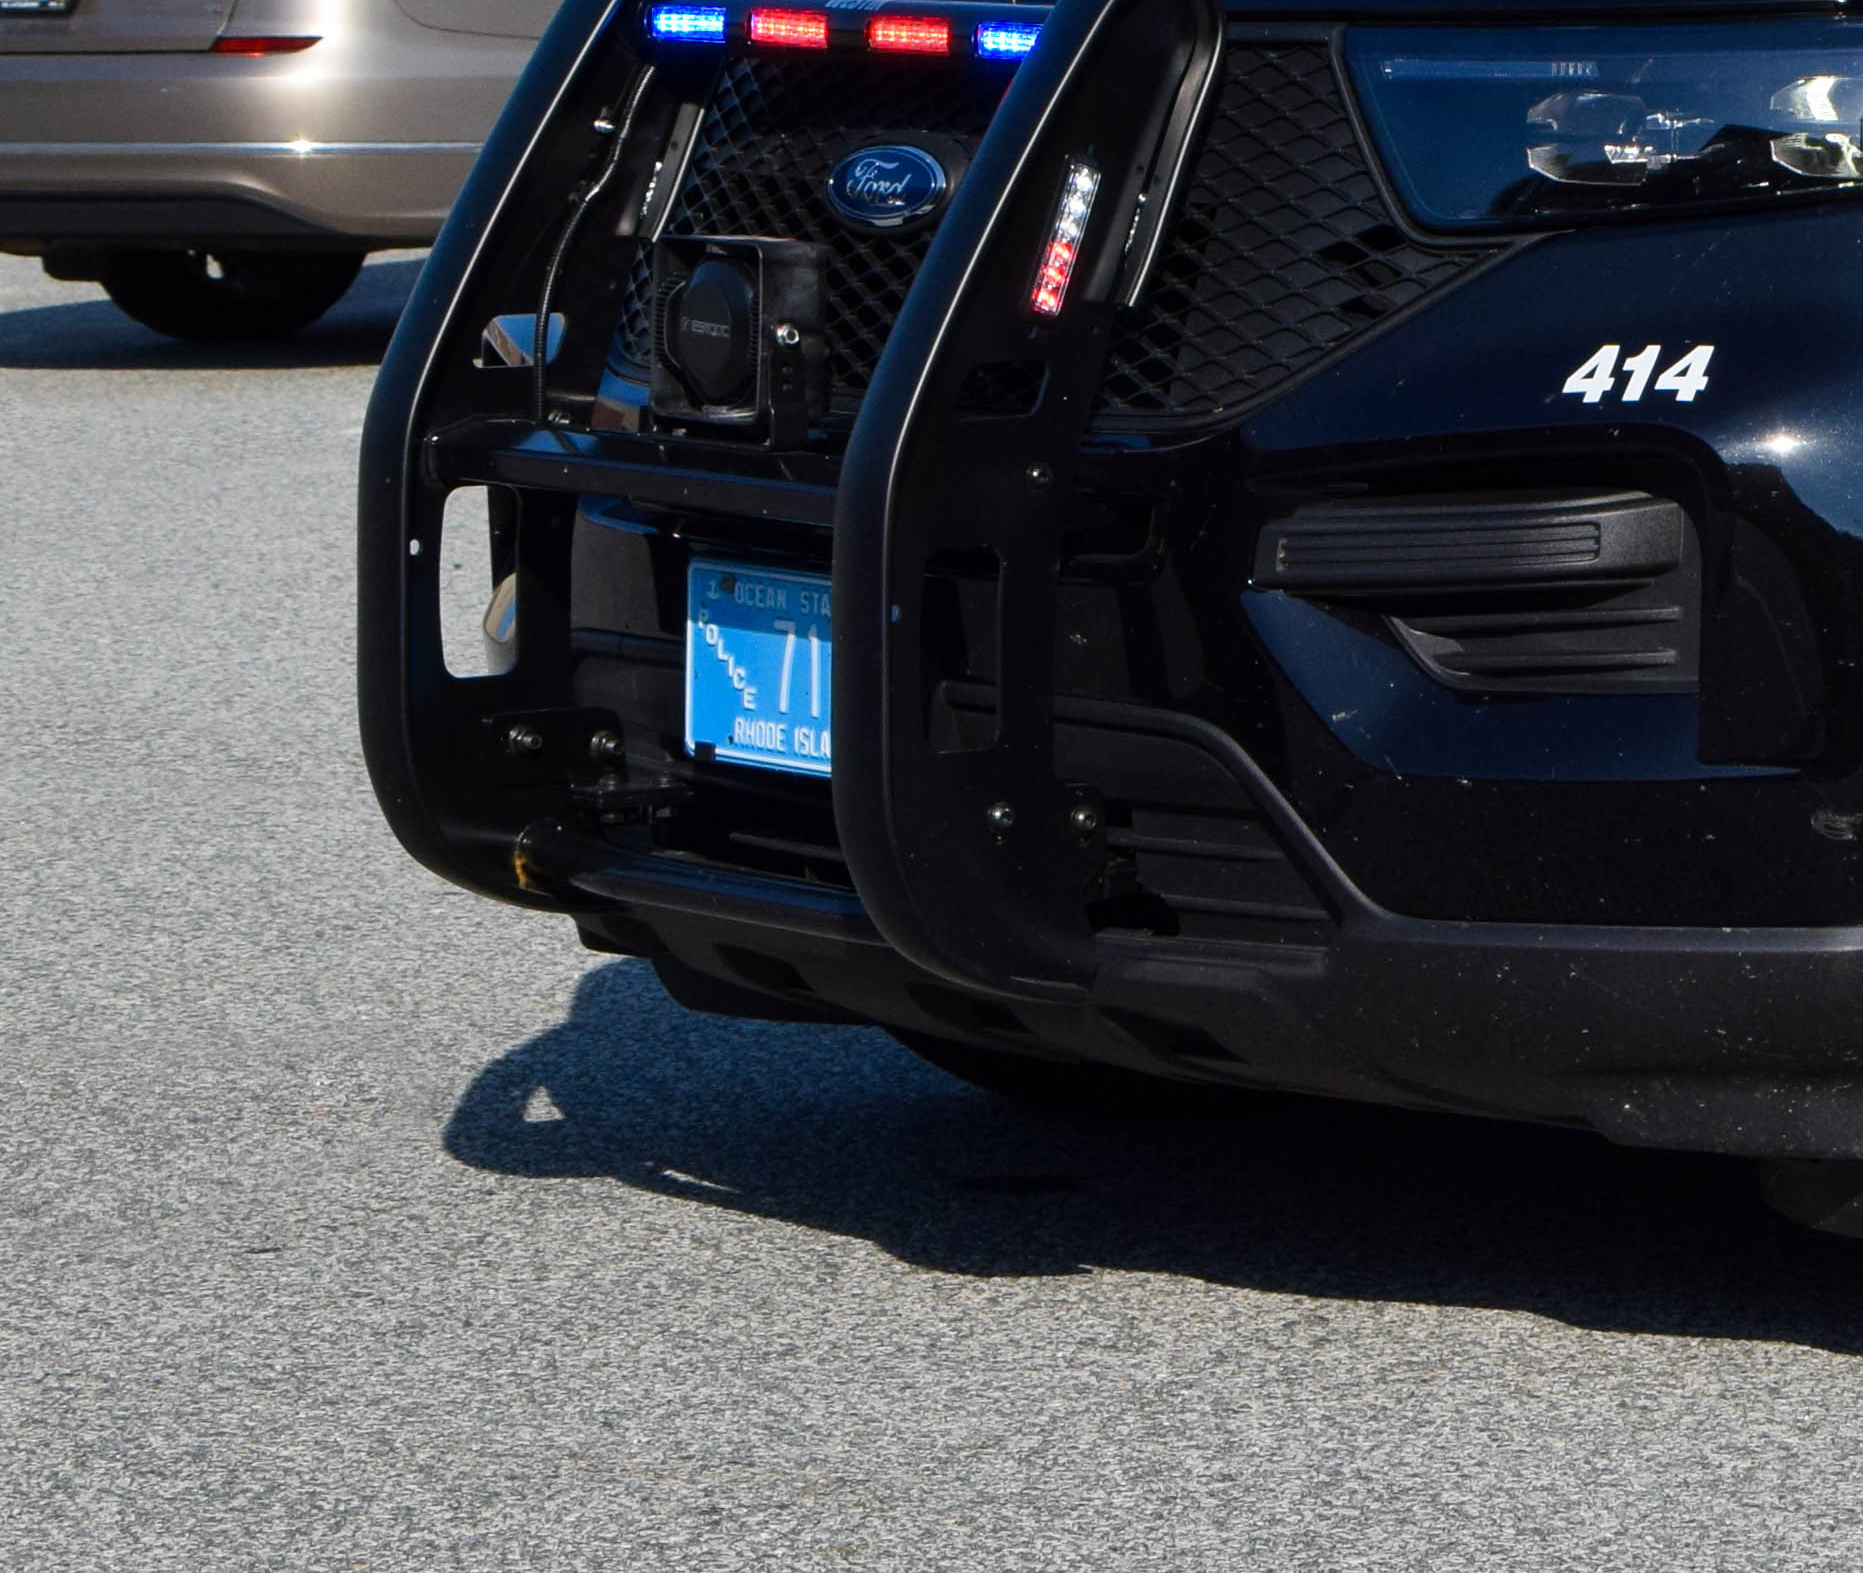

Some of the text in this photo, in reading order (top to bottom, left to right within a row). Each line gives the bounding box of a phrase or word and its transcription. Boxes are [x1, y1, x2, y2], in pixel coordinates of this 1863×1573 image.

[847, 158, 912, 201] Ford
[1562, 344, 1715, 404] 414
[734, 581, 787, 610] OCEAN
[698, 609, 758, 711] POLICE
[734, 716, 787, 753] RHODE
